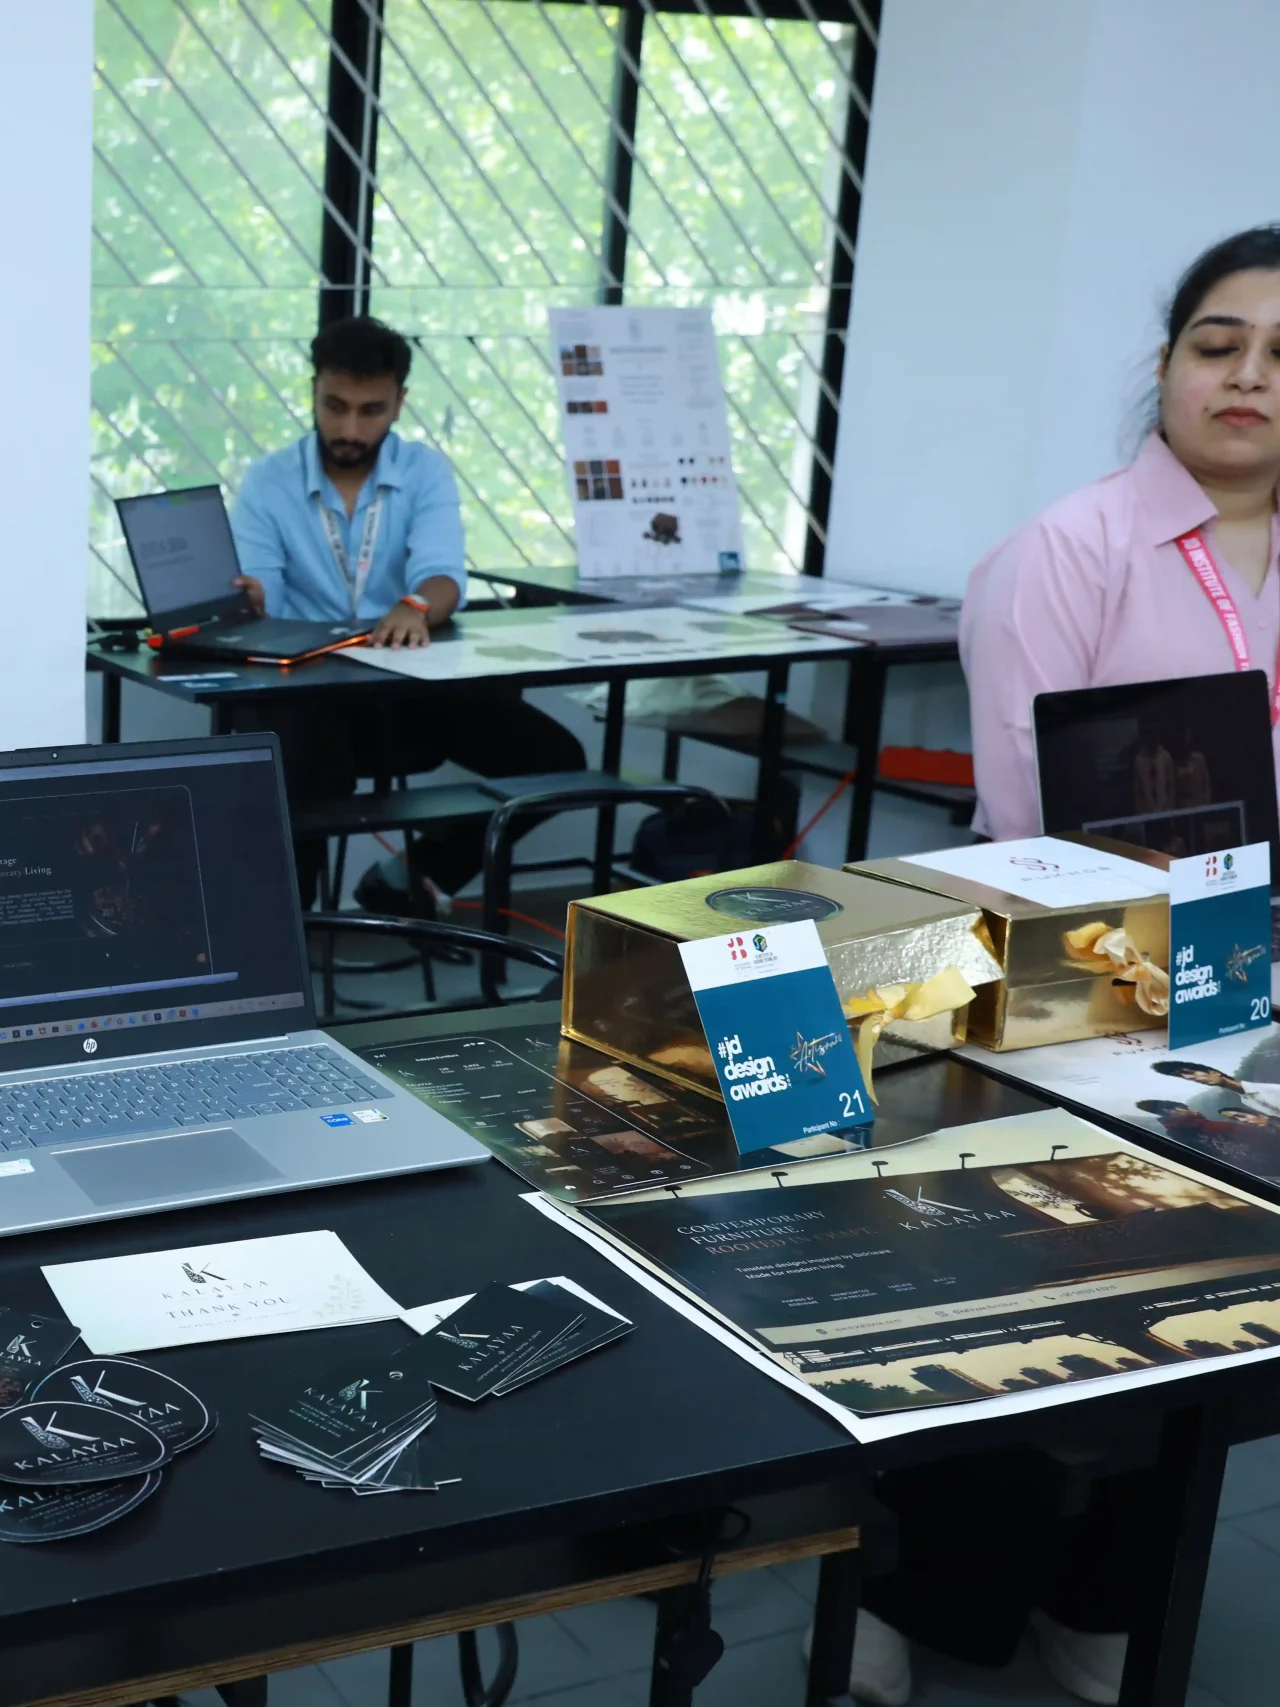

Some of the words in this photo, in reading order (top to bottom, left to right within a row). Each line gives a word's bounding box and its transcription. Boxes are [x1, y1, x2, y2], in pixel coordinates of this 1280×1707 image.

[1188, 549, 1226, 600] INSTITUTE
[25, 865, 52, 876] Living
[1176, 944, 1194, 969] #jd
[1175, 965, 1213, 986] design
[1175, 980, 1217, 1005] awards
[1250, 996, 1269, 1021] 20
[717, 1035, 743, 1061] #jd
[724, 1056, 776, 1081] design
[729, 1074, 788, 1101] awards
[838, 1089, 865, 1118] 21
[803, 1122, 830, 1134] Participant
[677, 1211, 826, 1235] CONTEMPORARY
[899, 1210, 1017, 1232] KALAYAA
[690, 1226, 805, 1245] FURNITURE.
[705, 1238, 786, 1255] ROOTED
[735, 1263, 774, 1273] Timeless
[775, 1260, 807, 1269] designs
[808, 1254, 841, 1265] inspired
[745, 1272, 771, 1280] Made
[786, 1266, 819, 1275] modern
[819, 1263, 846, 1271] living.
[161, 1279, 269, 1301] KALAYAA
[164, 1302, 241, 1320] THANK
[248, 1295, 291, 1309] YOU
[456, 1324, 524, 1371] KALAYAA
[14, 1437, 136, 1471] KALAYAA
